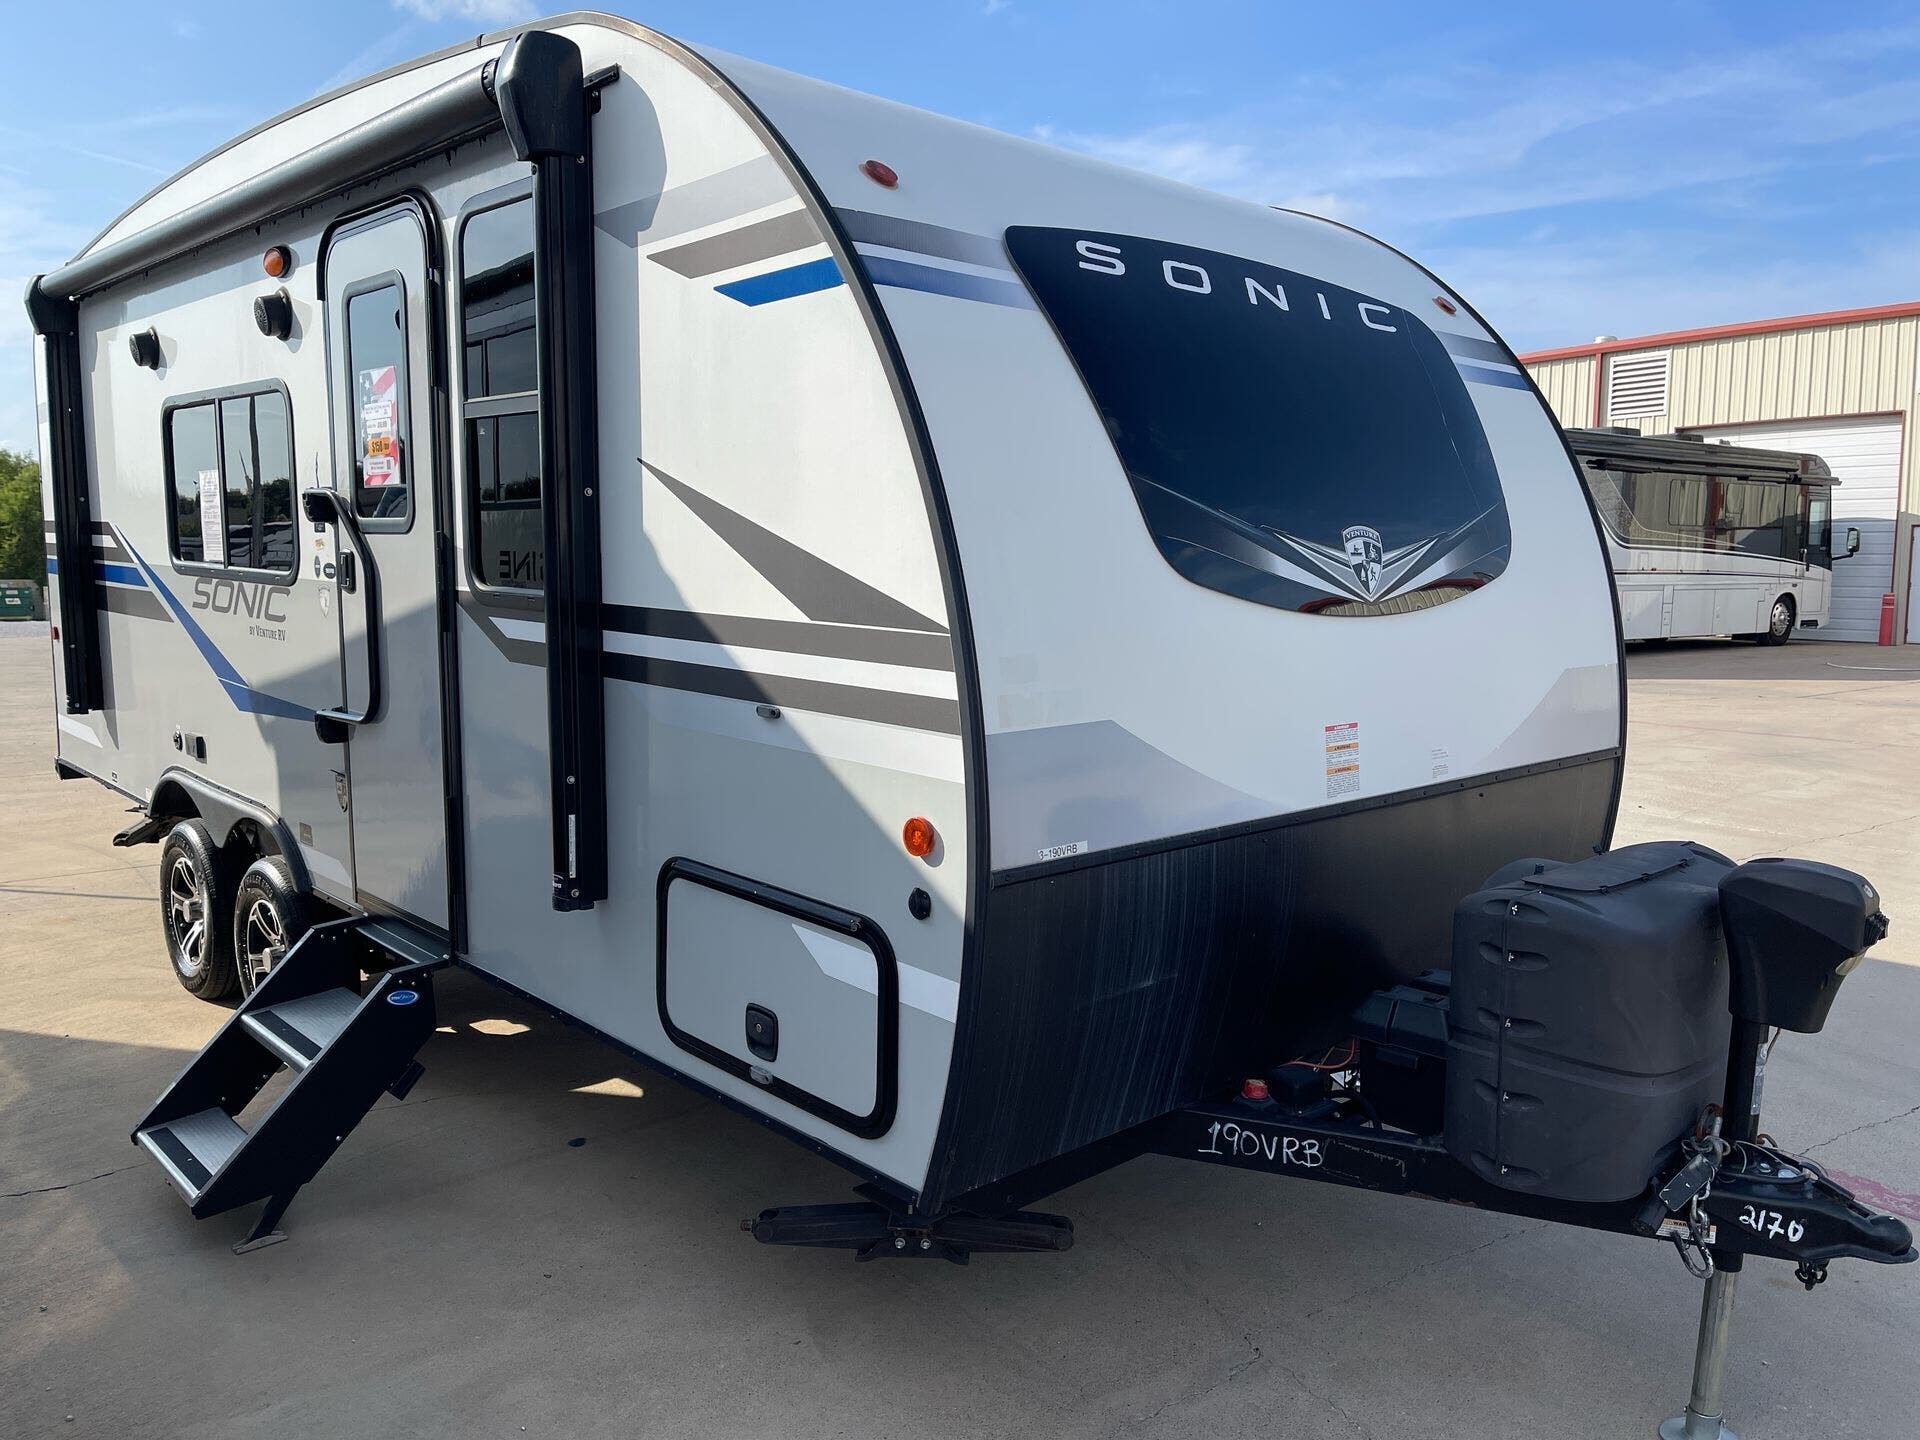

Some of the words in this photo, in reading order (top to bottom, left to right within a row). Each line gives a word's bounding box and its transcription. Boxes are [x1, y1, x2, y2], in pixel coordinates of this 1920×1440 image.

[1076, 240, 1397, 332] SONIC
[1346, 529, 1379, 540] VENTURE
[192, 578, 291, 623] SONIC
[277, 628, 287, 642] RV
[1197, 1121, 1324, 1168] 190VRB
[1739, 1204, 1805, 1243] 2170
